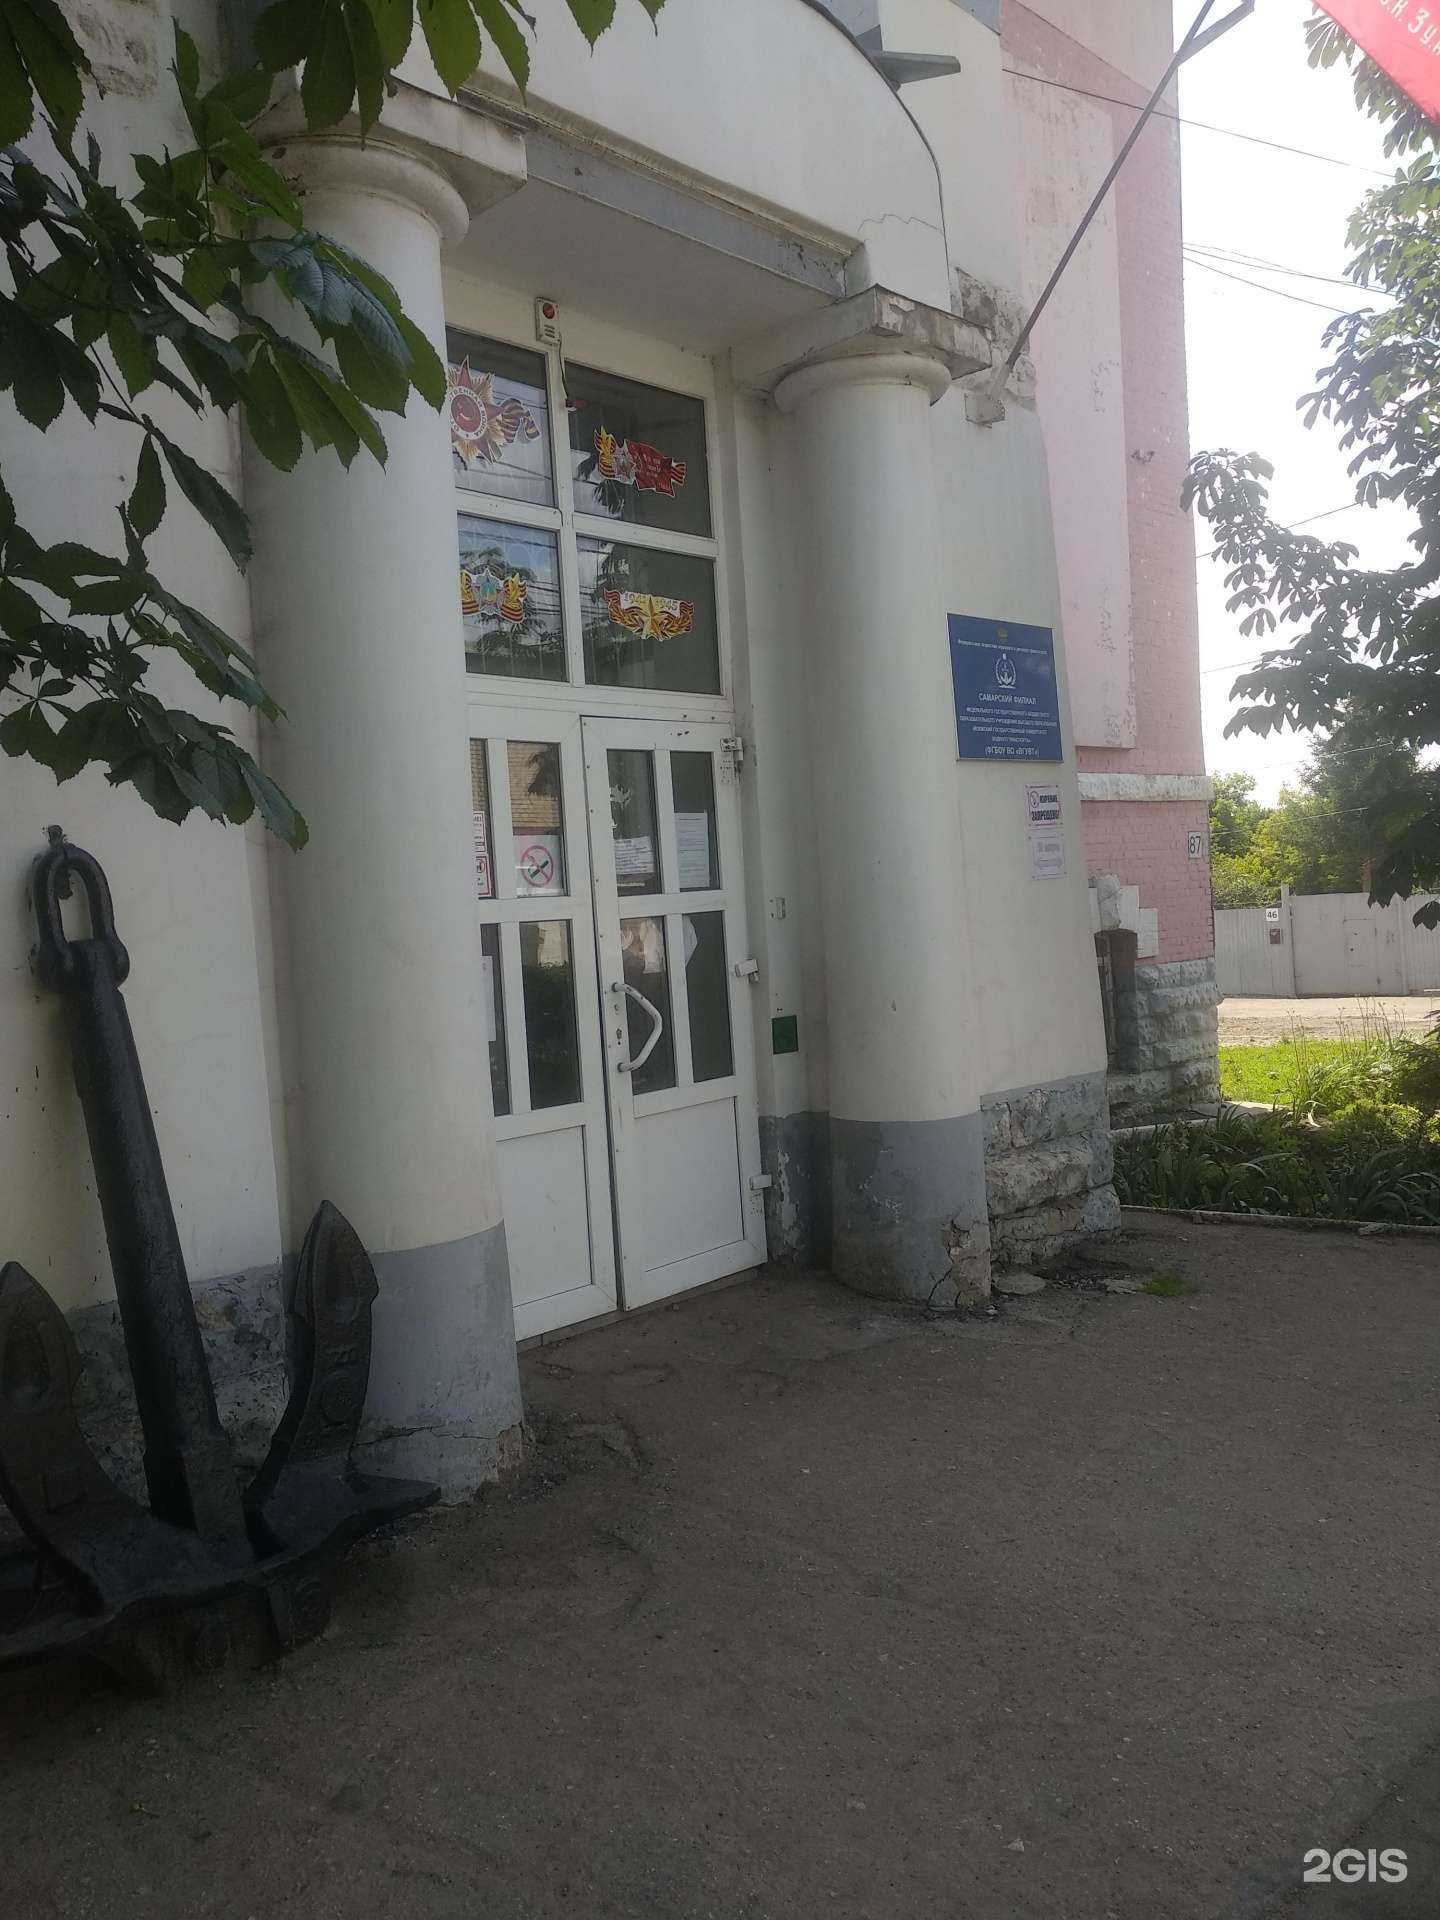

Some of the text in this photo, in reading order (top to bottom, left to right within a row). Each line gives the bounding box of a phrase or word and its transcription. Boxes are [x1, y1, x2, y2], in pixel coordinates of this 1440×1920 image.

[978, 693, 1036, 705] САМАРСКИЙ ФИЛИАЛ
[1189, 835, 1201, 854] 87
[1267, 910, 1278, 919] 46
